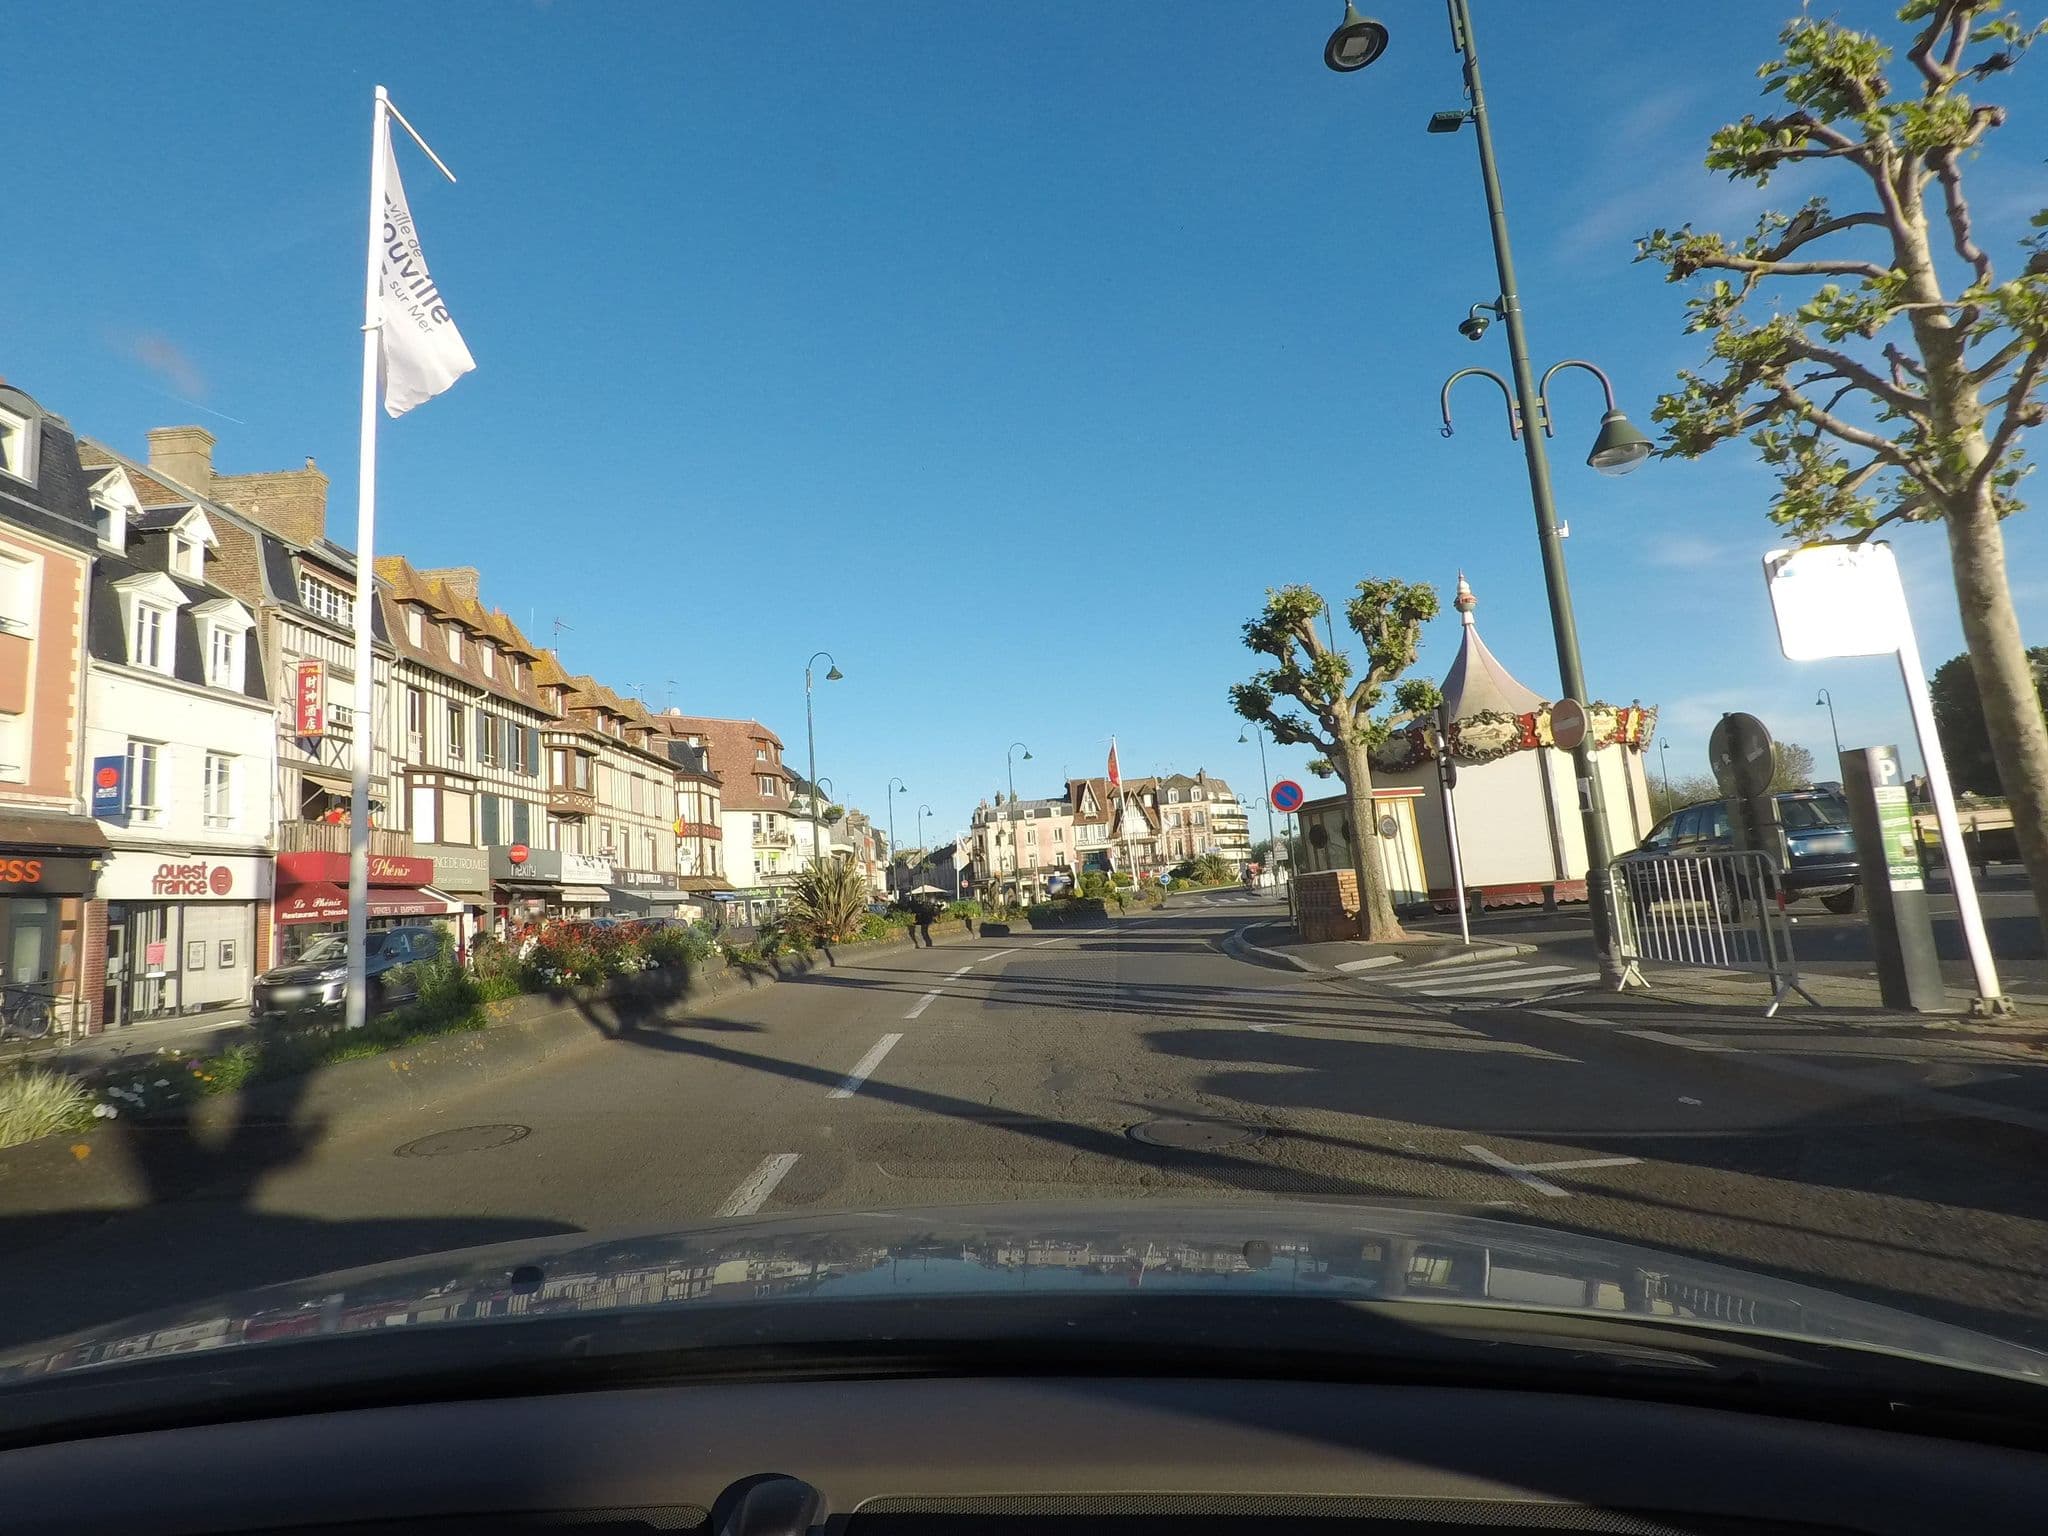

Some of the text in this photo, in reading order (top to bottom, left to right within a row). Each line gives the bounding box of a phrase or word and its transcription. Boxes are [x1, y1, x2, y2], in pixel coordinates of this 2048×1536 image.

[389, 203, 422, 258] ville de
[383, 192, 451, 324] ouville
[389, 280, 434, 334] sur Mer
[1880, 758, 1897, 786] P
[151, 874, 208, 895] france
[157, 861, 208, 880] ouest
[281, 908, 348, 919] Restaurant Chinois
